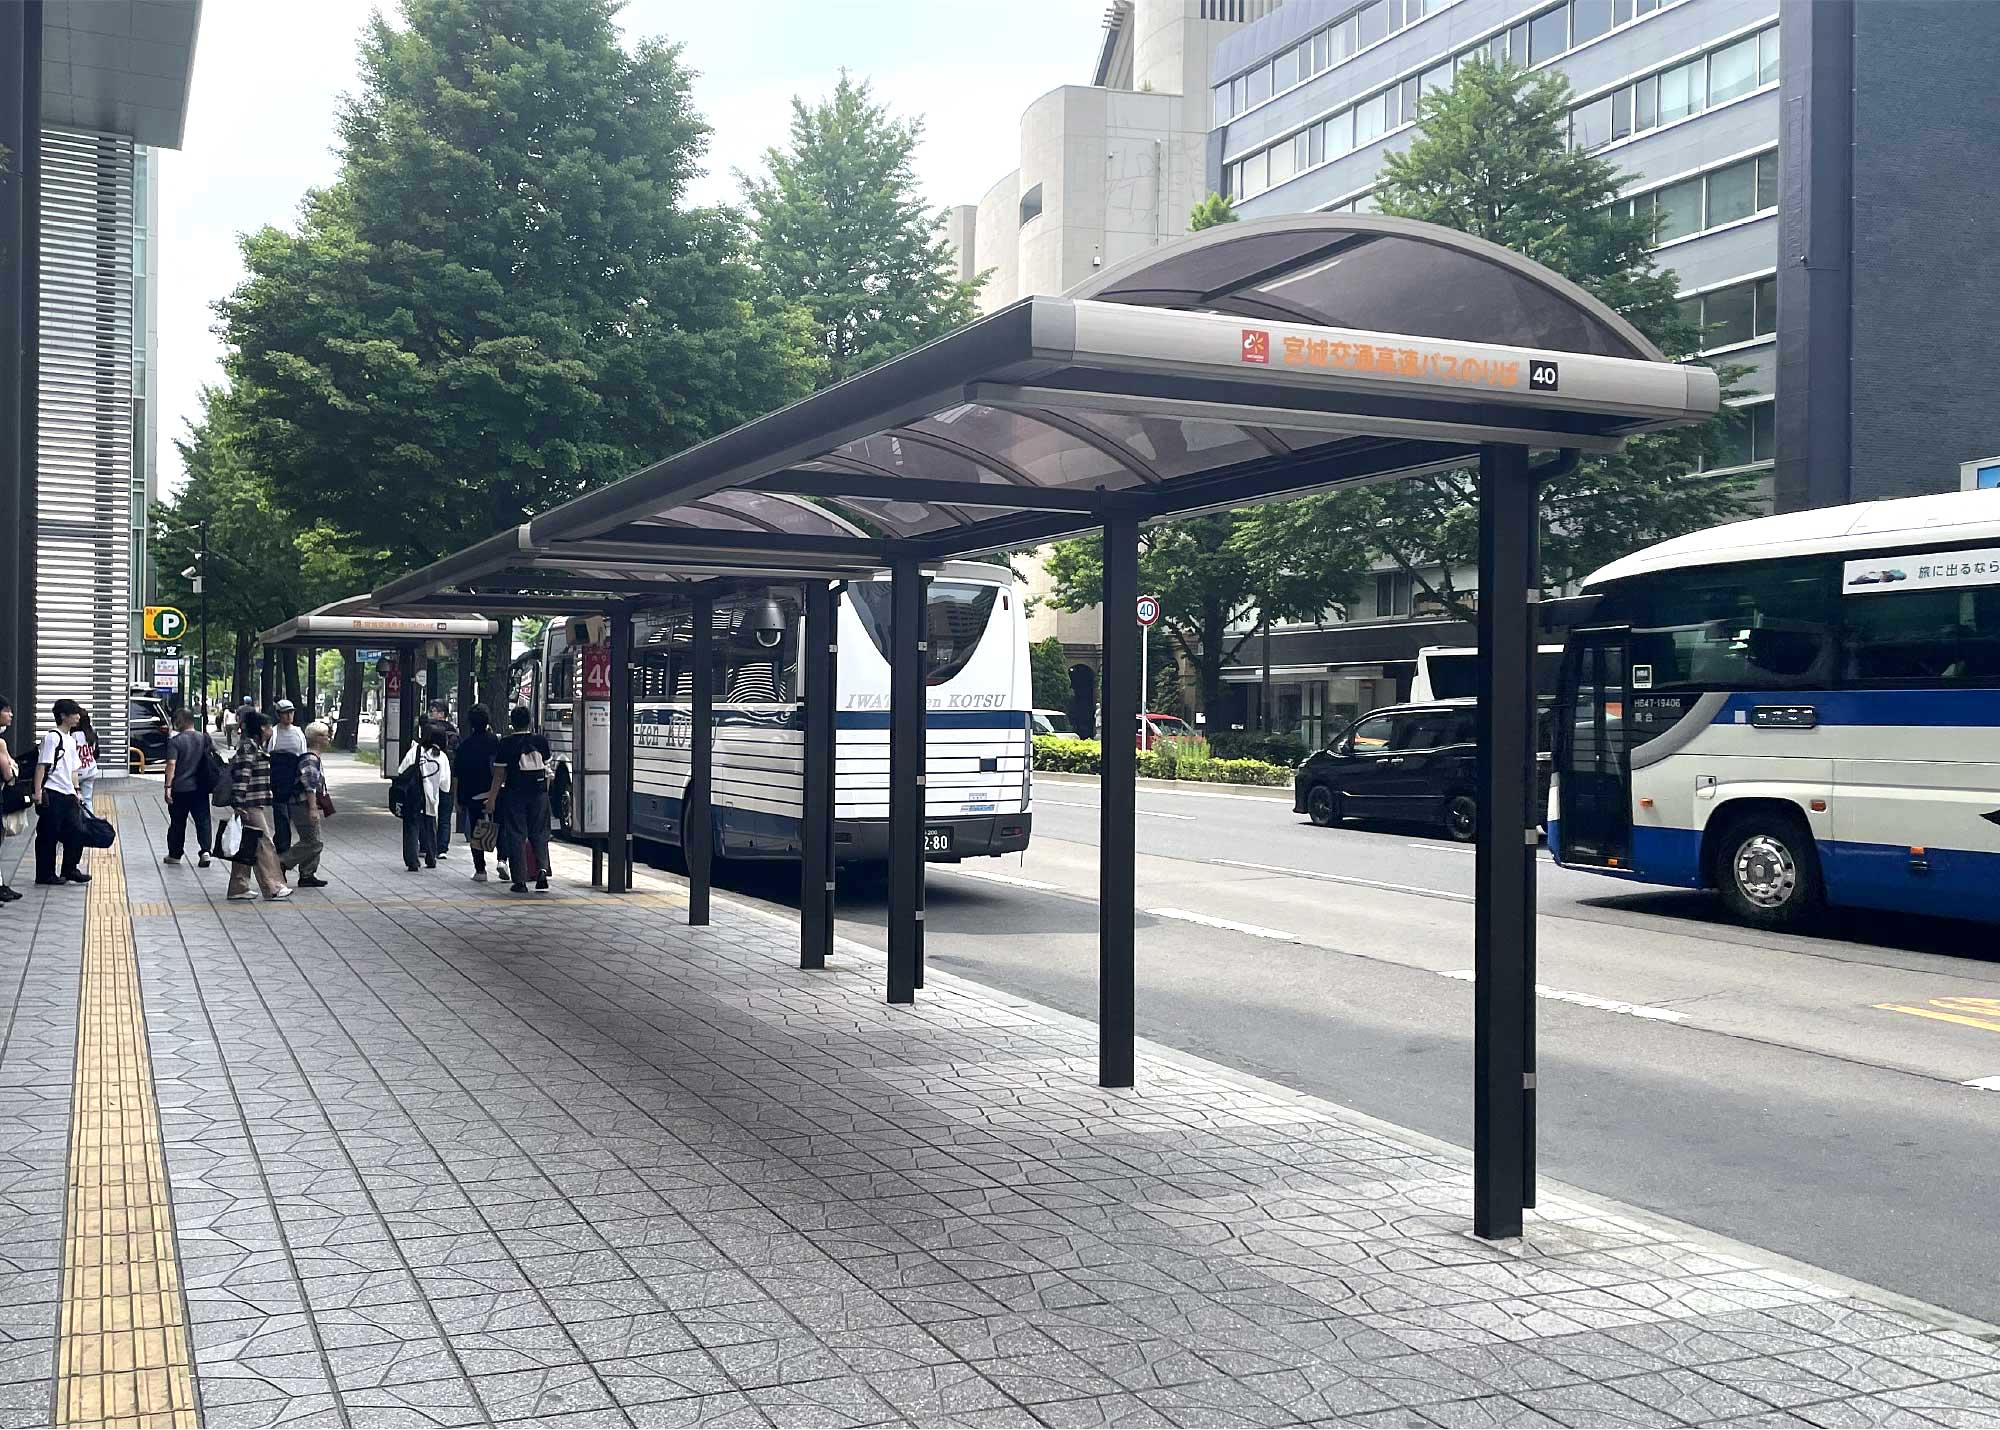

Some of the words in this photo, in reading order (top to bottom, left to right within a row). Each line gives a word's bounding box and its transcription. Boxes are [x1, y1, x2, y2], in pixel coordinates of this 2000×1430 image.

[1533, 366, 1556, 385] 40
[1918, 560, 2000, 579] 旅に出るなら
[1139, 603, 1153, 616] 40
[162, 613, 180, 635] P
[388, 676, 400, 691] 4
[946, 694, 1006, 708] KOTSU
[924, 835, 948, 850] 2-80
